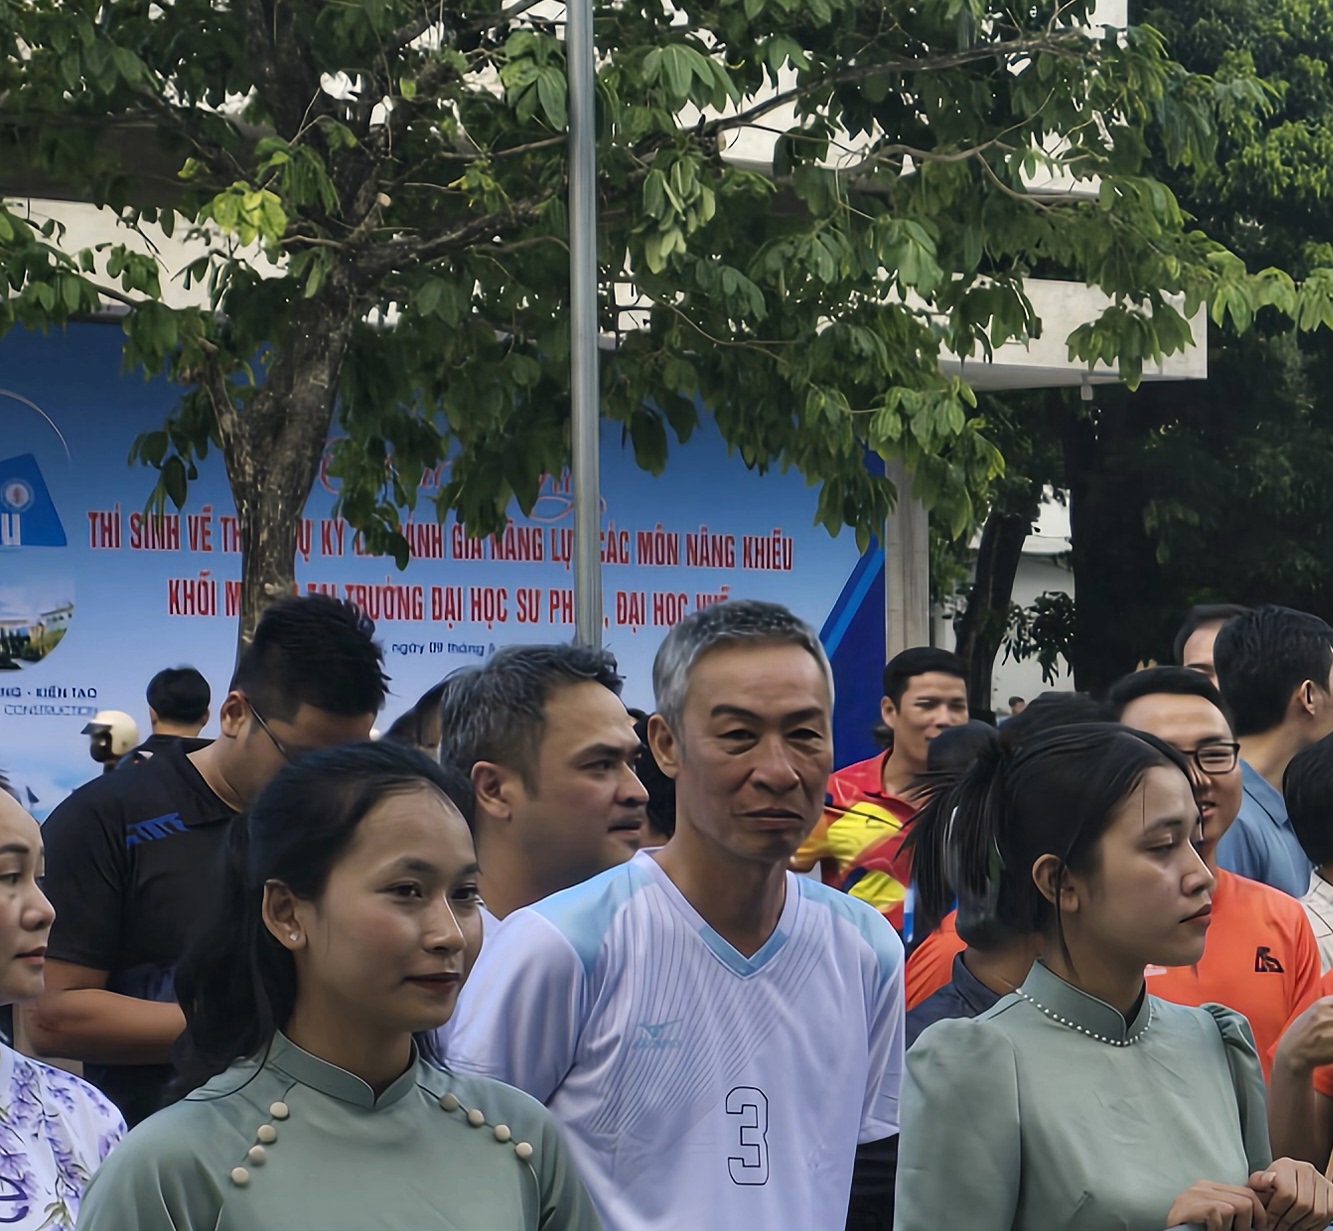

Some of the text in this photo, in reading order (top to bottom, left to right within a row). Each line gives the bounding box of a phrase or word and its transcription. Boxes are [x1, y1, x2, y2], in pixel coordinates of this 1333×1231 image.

[88, 502, 121, 549] THÍ
[130, 512, 181, 551] SINH
[188, 505, 214, 552] VỀ
[637, 523, 680, 566] MÔN
[686, 524, 737, 569] NĂNG
[742, 527, 794, 572] KHIẾU
[167, 570, 217, 617] KHỐI
[431, 586, 463, 629] ĐẠI
[470, 586, 509, 630] HỌC
[516, 588, 543, 624] SƯ
[616, 591, 646, 634] ĐẠI
[725, 1086, 770, 1186] 3
